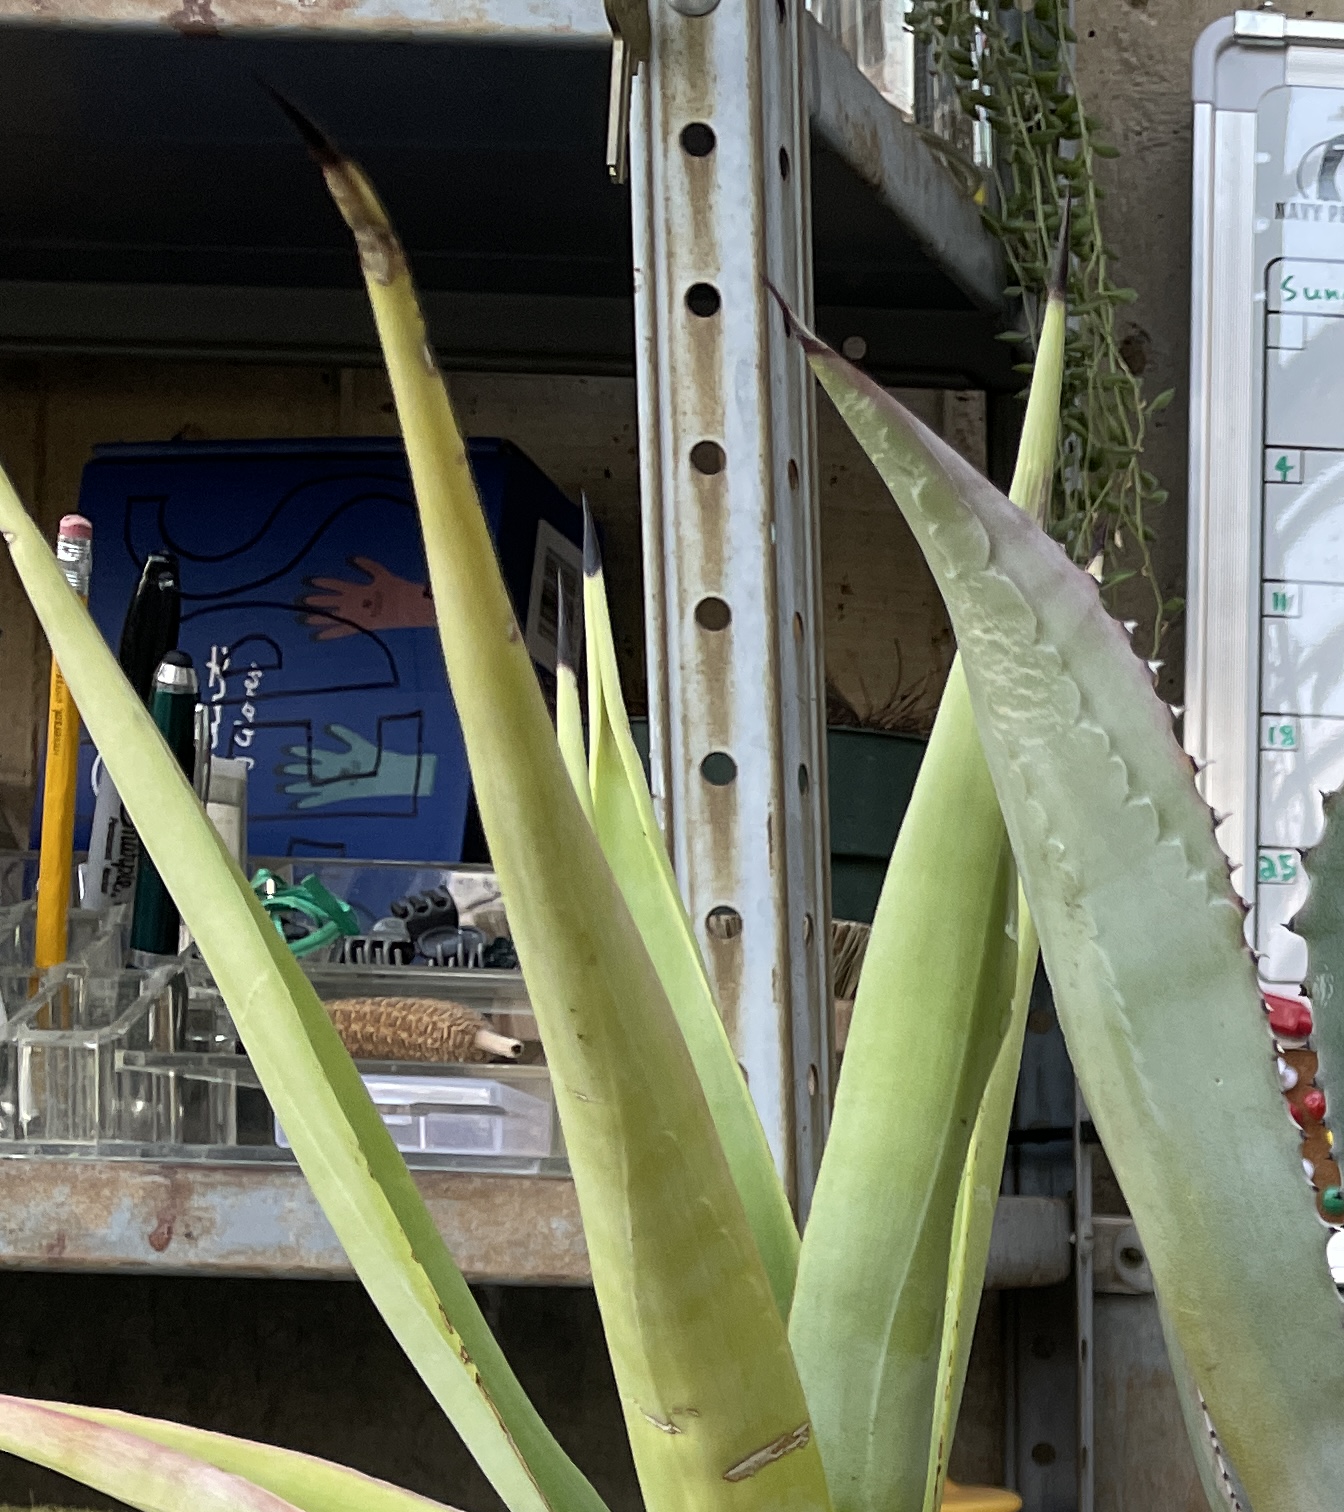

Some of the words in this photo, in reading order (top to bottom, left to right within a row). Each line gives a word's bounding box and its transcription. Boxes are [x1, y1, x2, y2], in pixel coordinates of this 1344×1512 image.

[1274, 455, 1295, 479] 4
[1268, 723, 1296, 747] 18
[1258, 854, 1297, 883] 25
